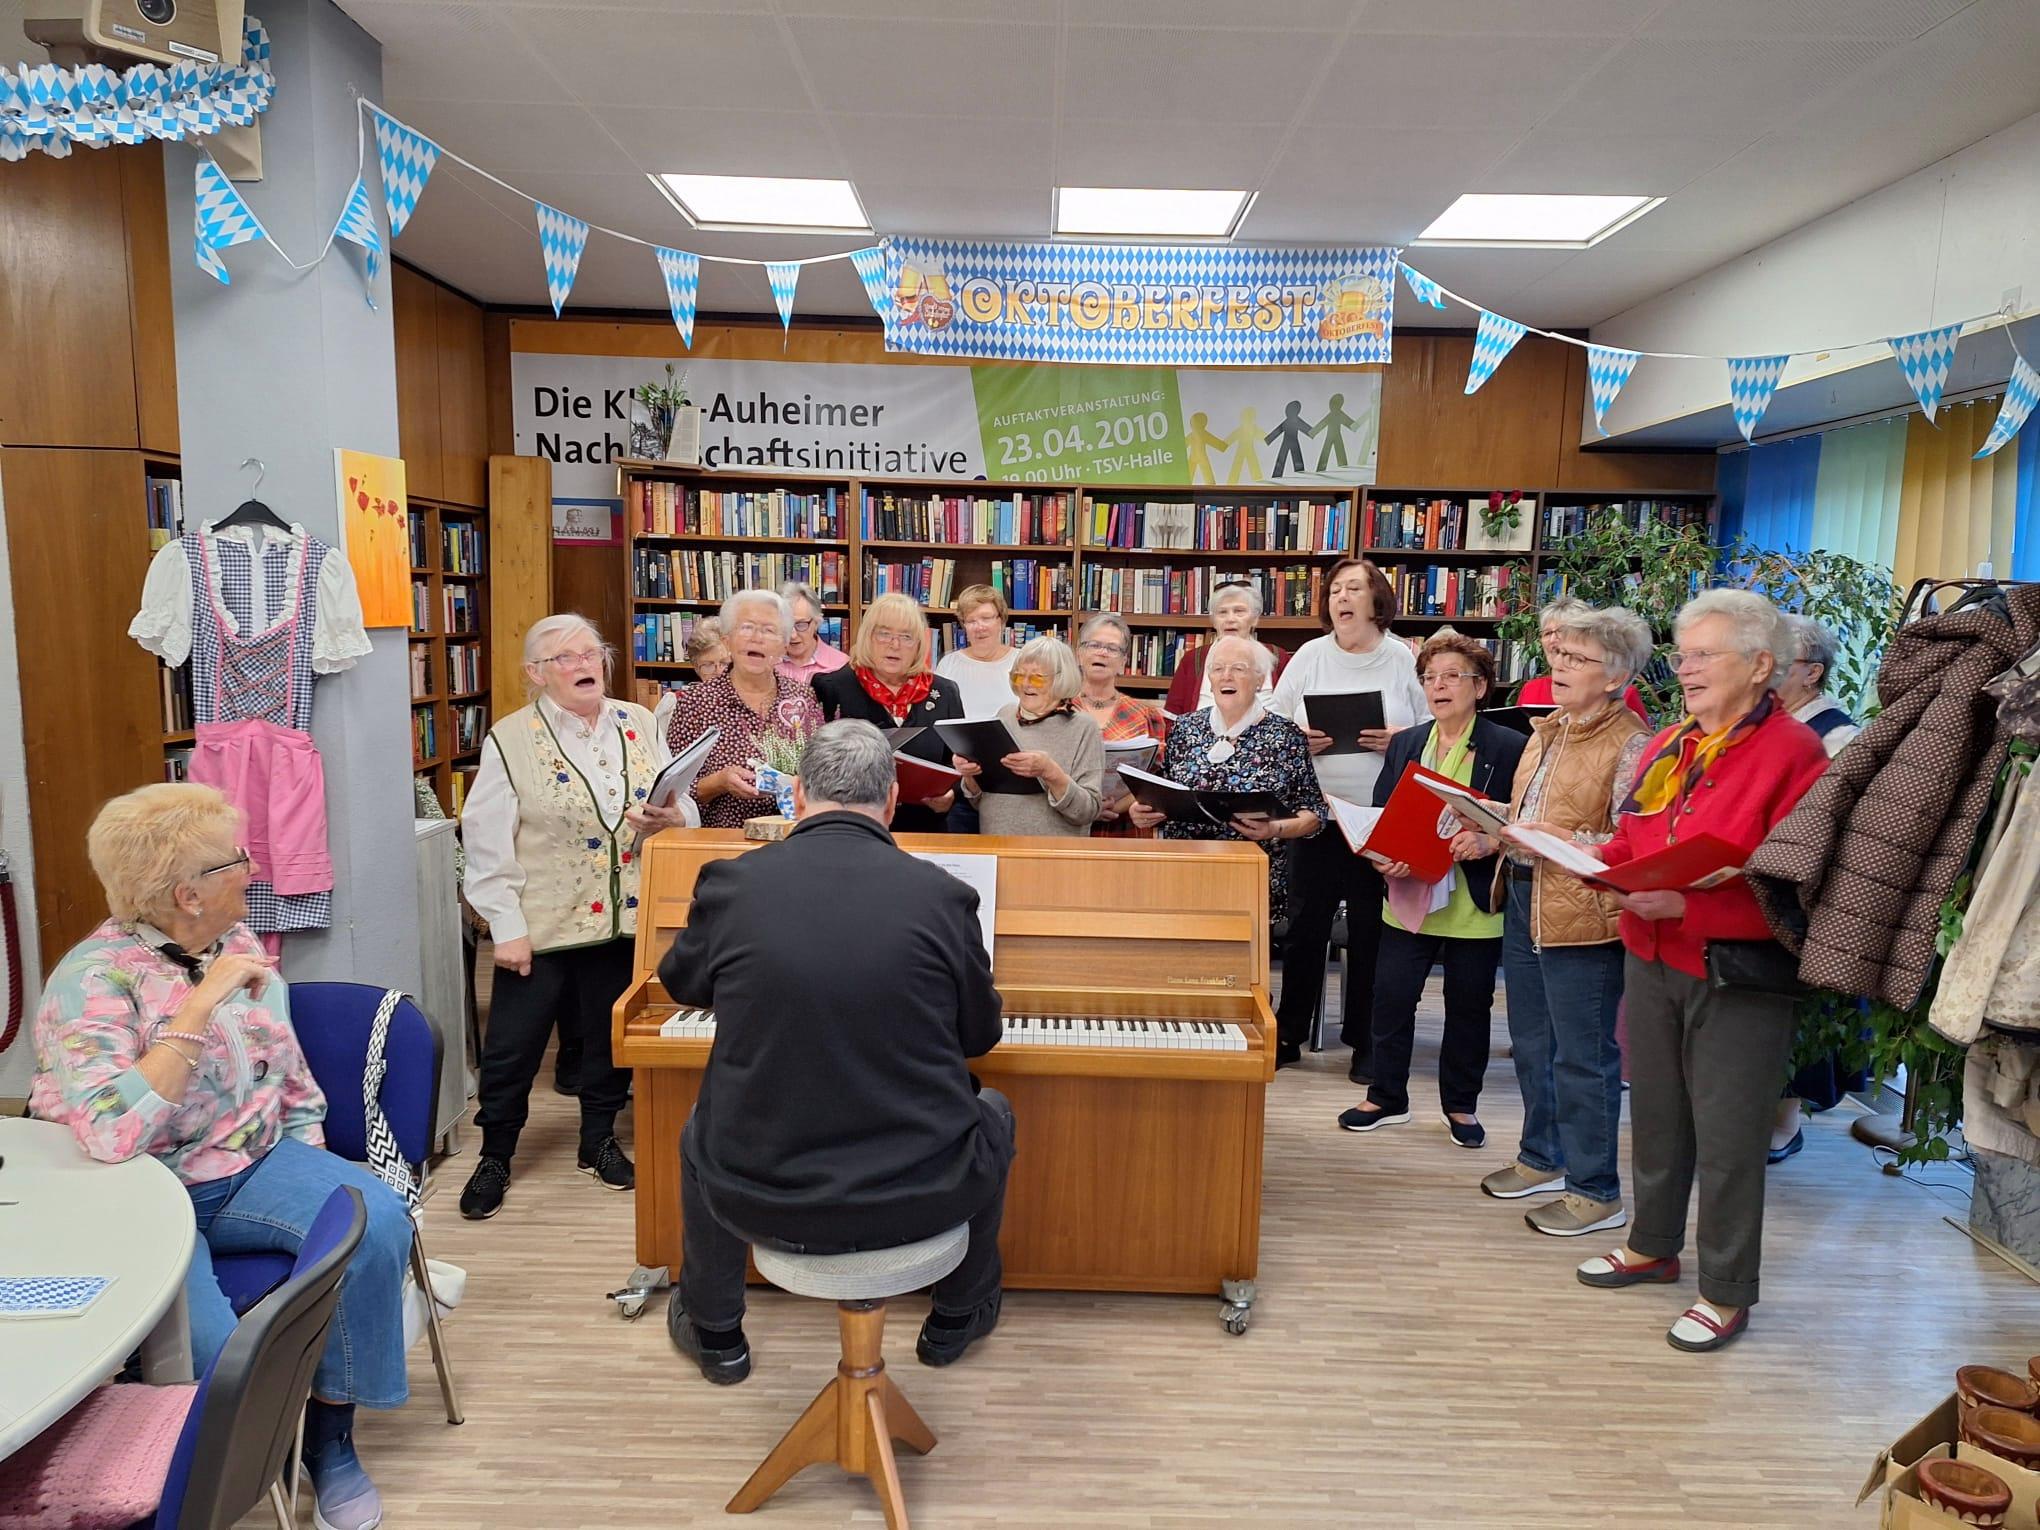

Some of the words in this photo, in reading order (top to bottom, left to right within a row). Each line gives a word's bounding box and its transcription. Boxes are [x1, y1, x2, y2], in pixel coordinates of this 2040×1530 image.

[960, 276, 1317, 332] OKTOBERFEST
[534, 386, 592, 419] Die
[604, 388, 884, 427] K-Auheimer
[993, 390, 1166, 428] AUFTAKTVERANSTALTUNG:
[997, 411, 1169, 466] 23.04.2010
[1051, 463, 1082, 482] Uhr
[1092, 448, 1173, 475] TSV-Halle
